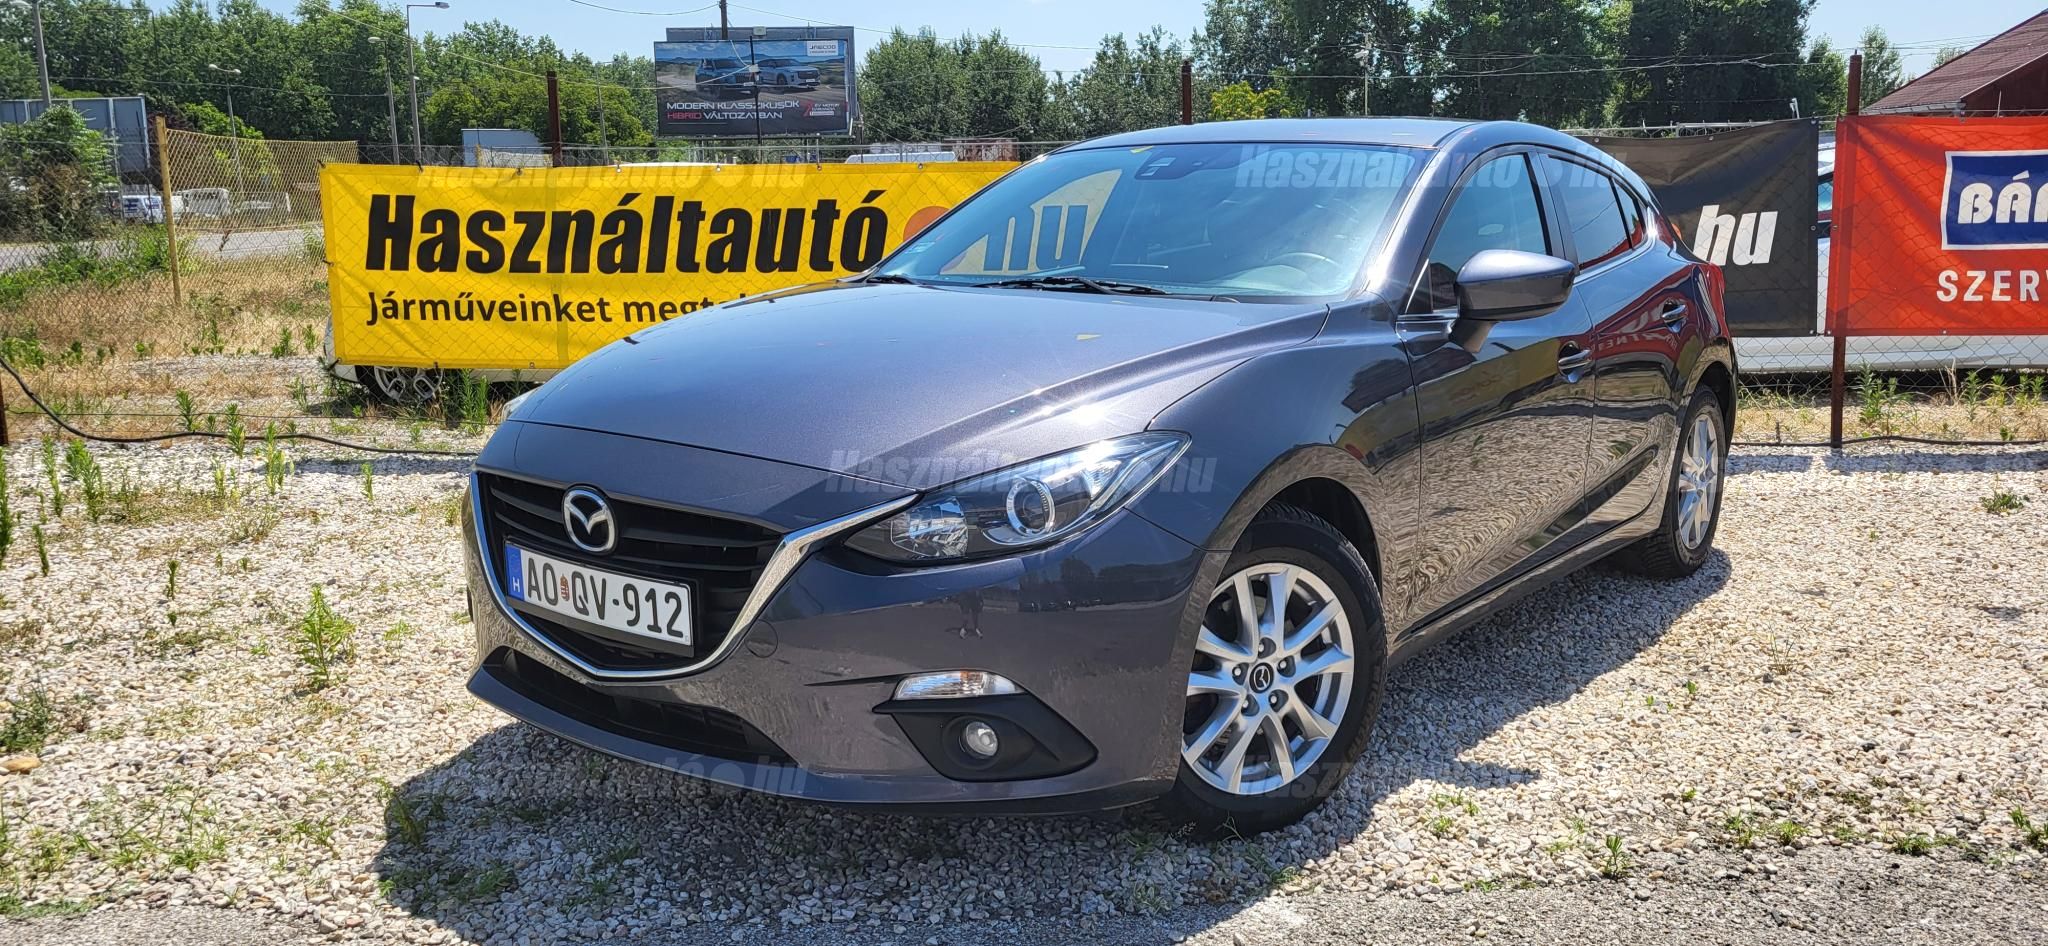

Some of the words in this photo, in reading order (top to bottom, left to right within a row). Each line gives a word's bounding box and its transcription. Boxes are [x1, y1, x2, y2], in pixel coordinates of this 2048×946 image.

[666, 102, 715, 110] MODERN
[667, 112, 702, 120] HIBRID
[703, 110, 783, 120] VÁLTOZATBAN
[366, 190, 888, 273] Használtautó
[1936, 270, 2048, 302] SZER
[366, 290, 613, 326] Járműveinket
[512, 576, 521, 591] H
